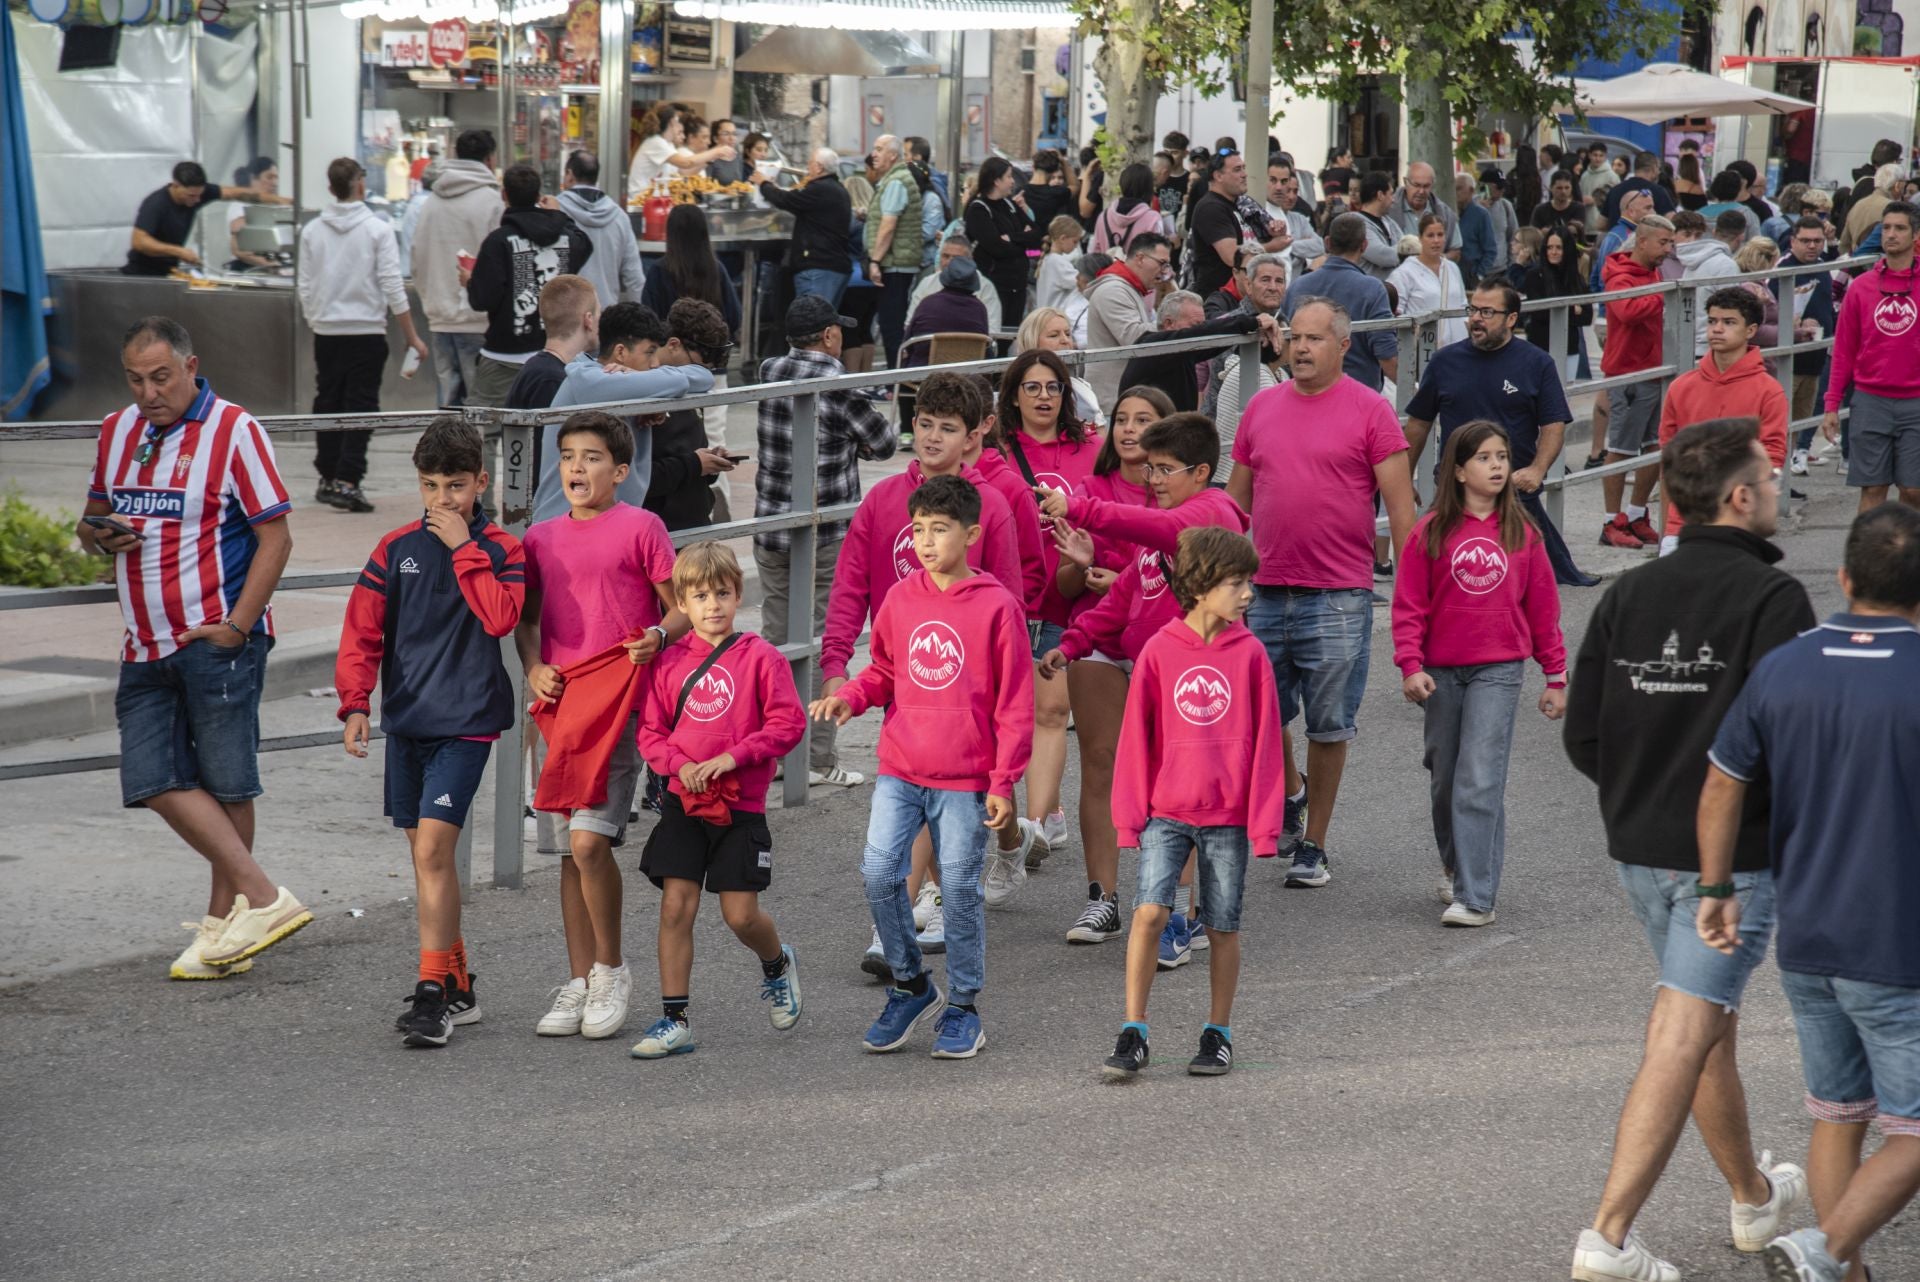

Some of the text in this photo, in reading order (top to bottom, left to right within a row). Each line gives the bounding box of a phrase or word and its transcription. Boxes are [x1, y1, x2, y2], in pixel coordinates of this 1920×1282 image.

[1422, 331, 1435, 343] 10
[510, 440, 523, 466] 8
[133, 492, 181, 515] gijón
